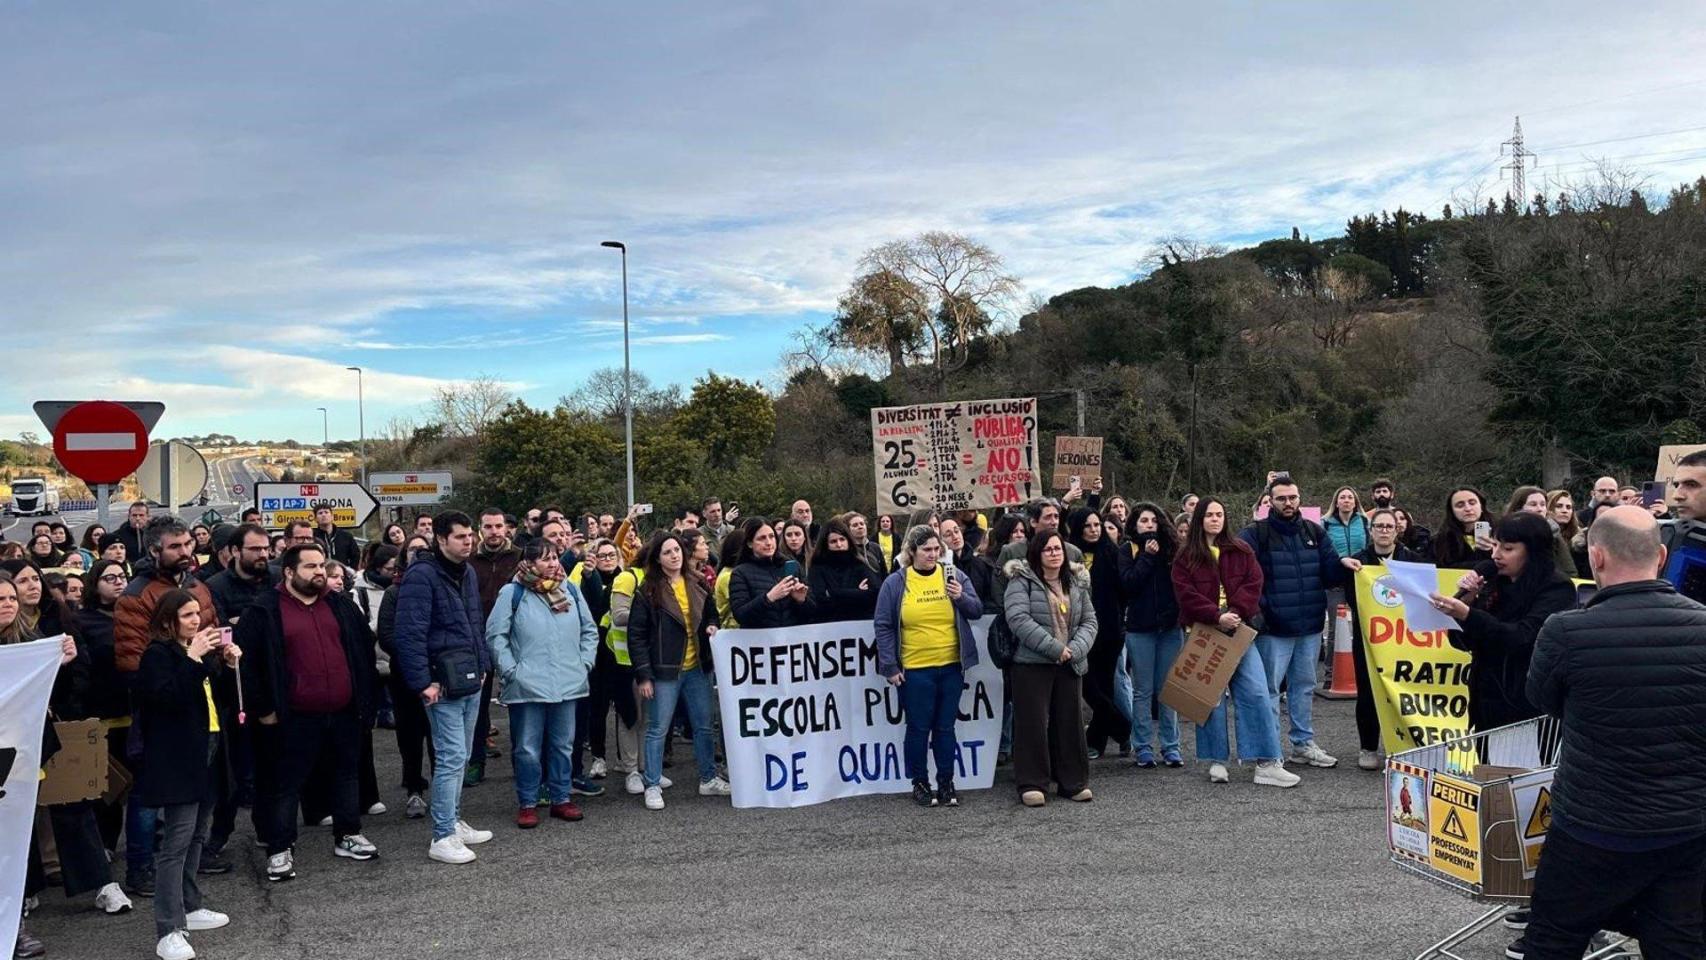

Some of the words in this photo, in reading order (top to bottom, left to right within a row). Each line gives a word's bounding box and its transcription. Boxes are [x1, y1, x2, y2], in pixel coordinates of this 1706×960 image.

[885, 439, 916, 469] 25
[938, 445, 960, 453] TDHA
[939, 453, 957, 462] TEA
[883, 469, 919, 479] ALUMNES
[941, 463, 957, 472] DLX
[942, 484, 954, 493] AA
[993, 483, 1020, 504] JA
[284, 499, 305, 509] AP-7
[333, 513, 354, 521] Brava
[1194, 630, 1212, 649] DE
[731, 638, 880, 686] DEFENSEM
[739, 692, 842, 738] ESCOLA
[765, 751, 809, 792] DE
[1433, 783, 1476, 809] PERILL
[1431, 835, 1478, 860] PROFESSORAT
[1434, 848, 1475, 871] EMPRENYAT
